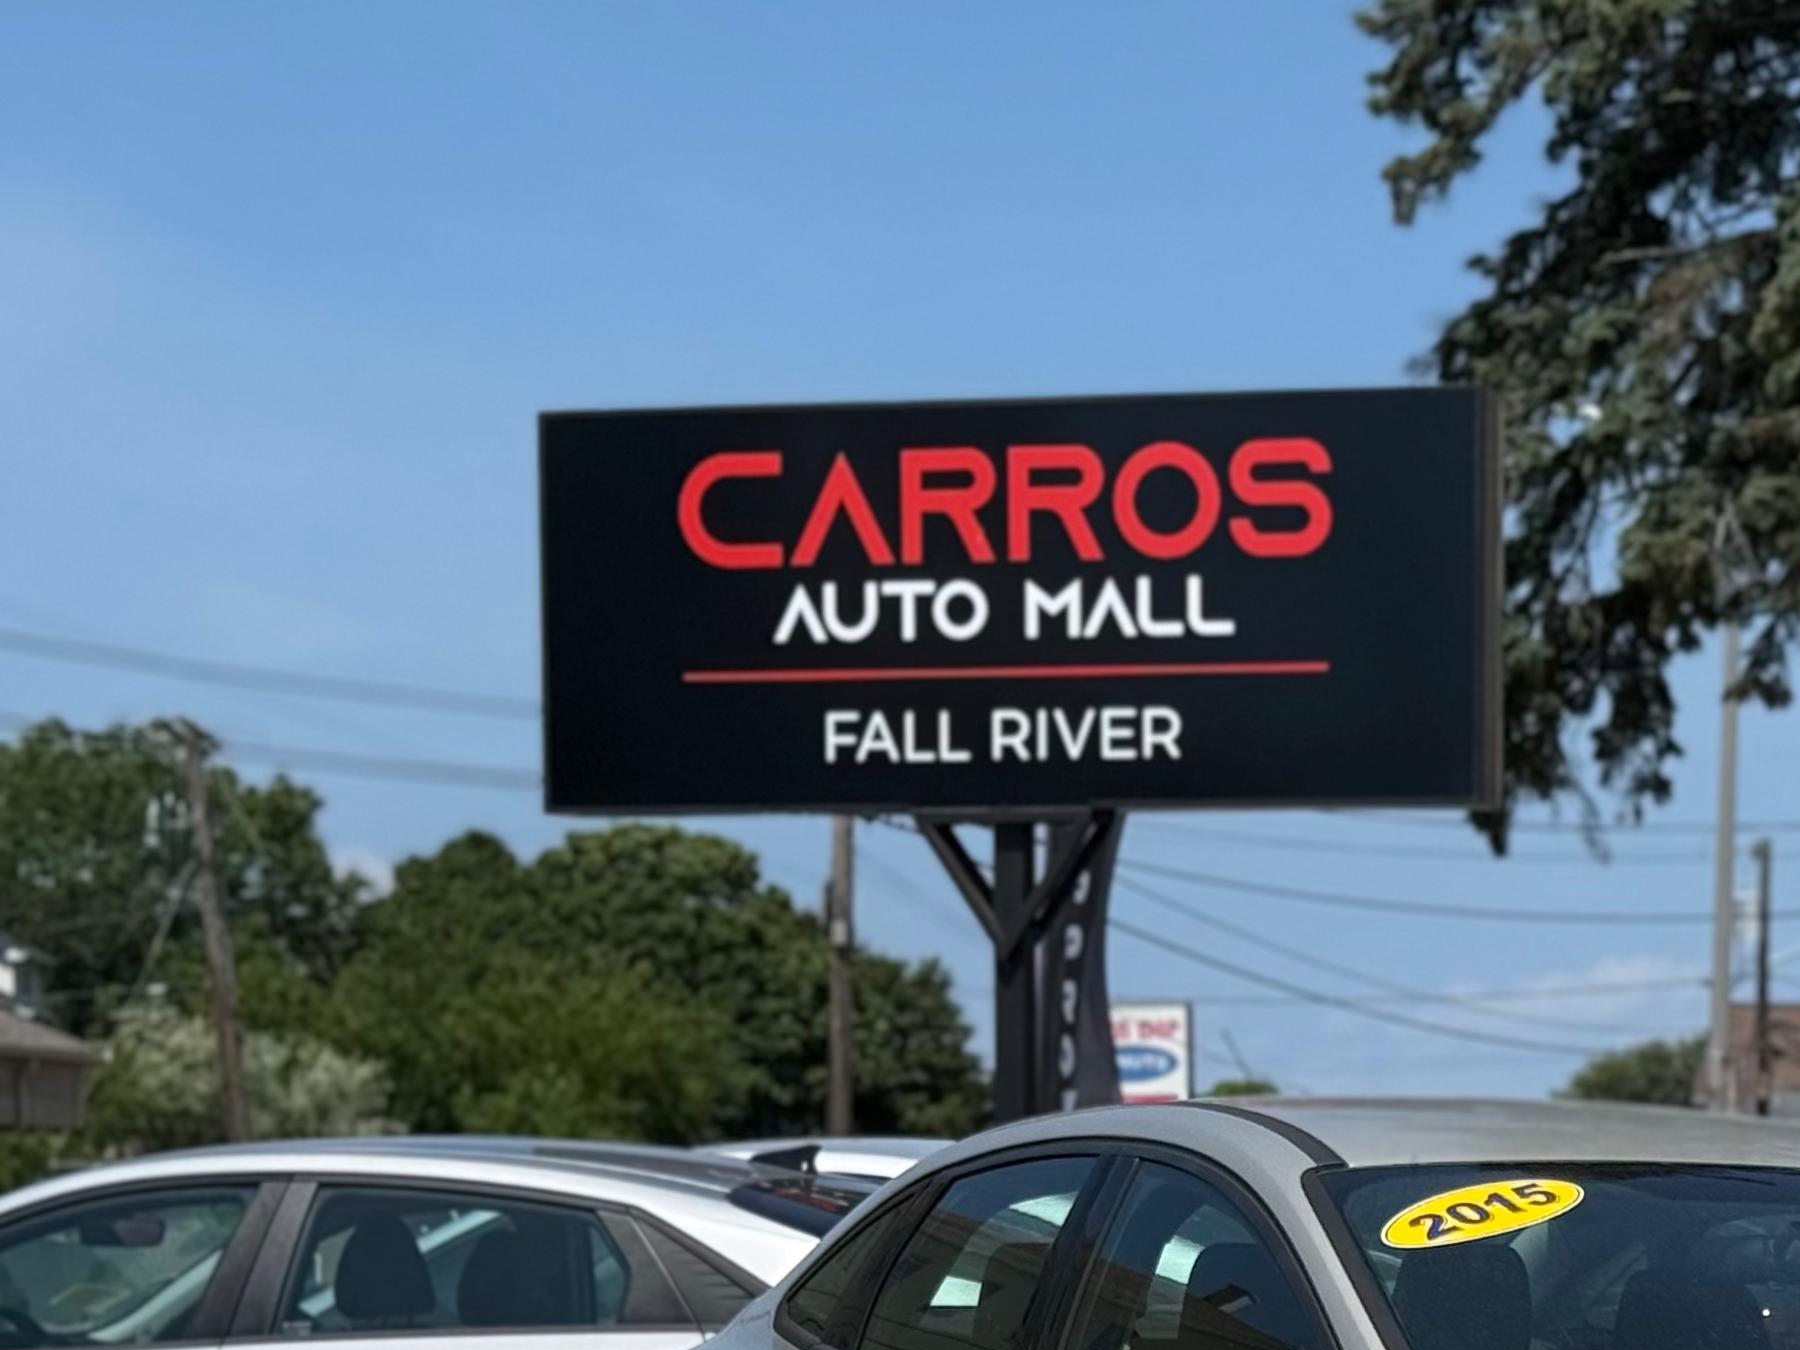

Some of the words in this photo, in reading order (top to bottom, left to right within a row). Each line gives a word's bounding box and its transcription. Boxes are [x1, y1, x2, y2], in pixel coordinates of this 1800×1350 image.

[677, 437, 1333, 570] CARROS
[773, 578, 989, 644] AUTO
[1023, 574, 1236, 640] MALL
[824, 709, 972, 763] FALL
[990, 705, 1182, 761] RIVER
[1408, 1183, 1558, 1241] 2015
